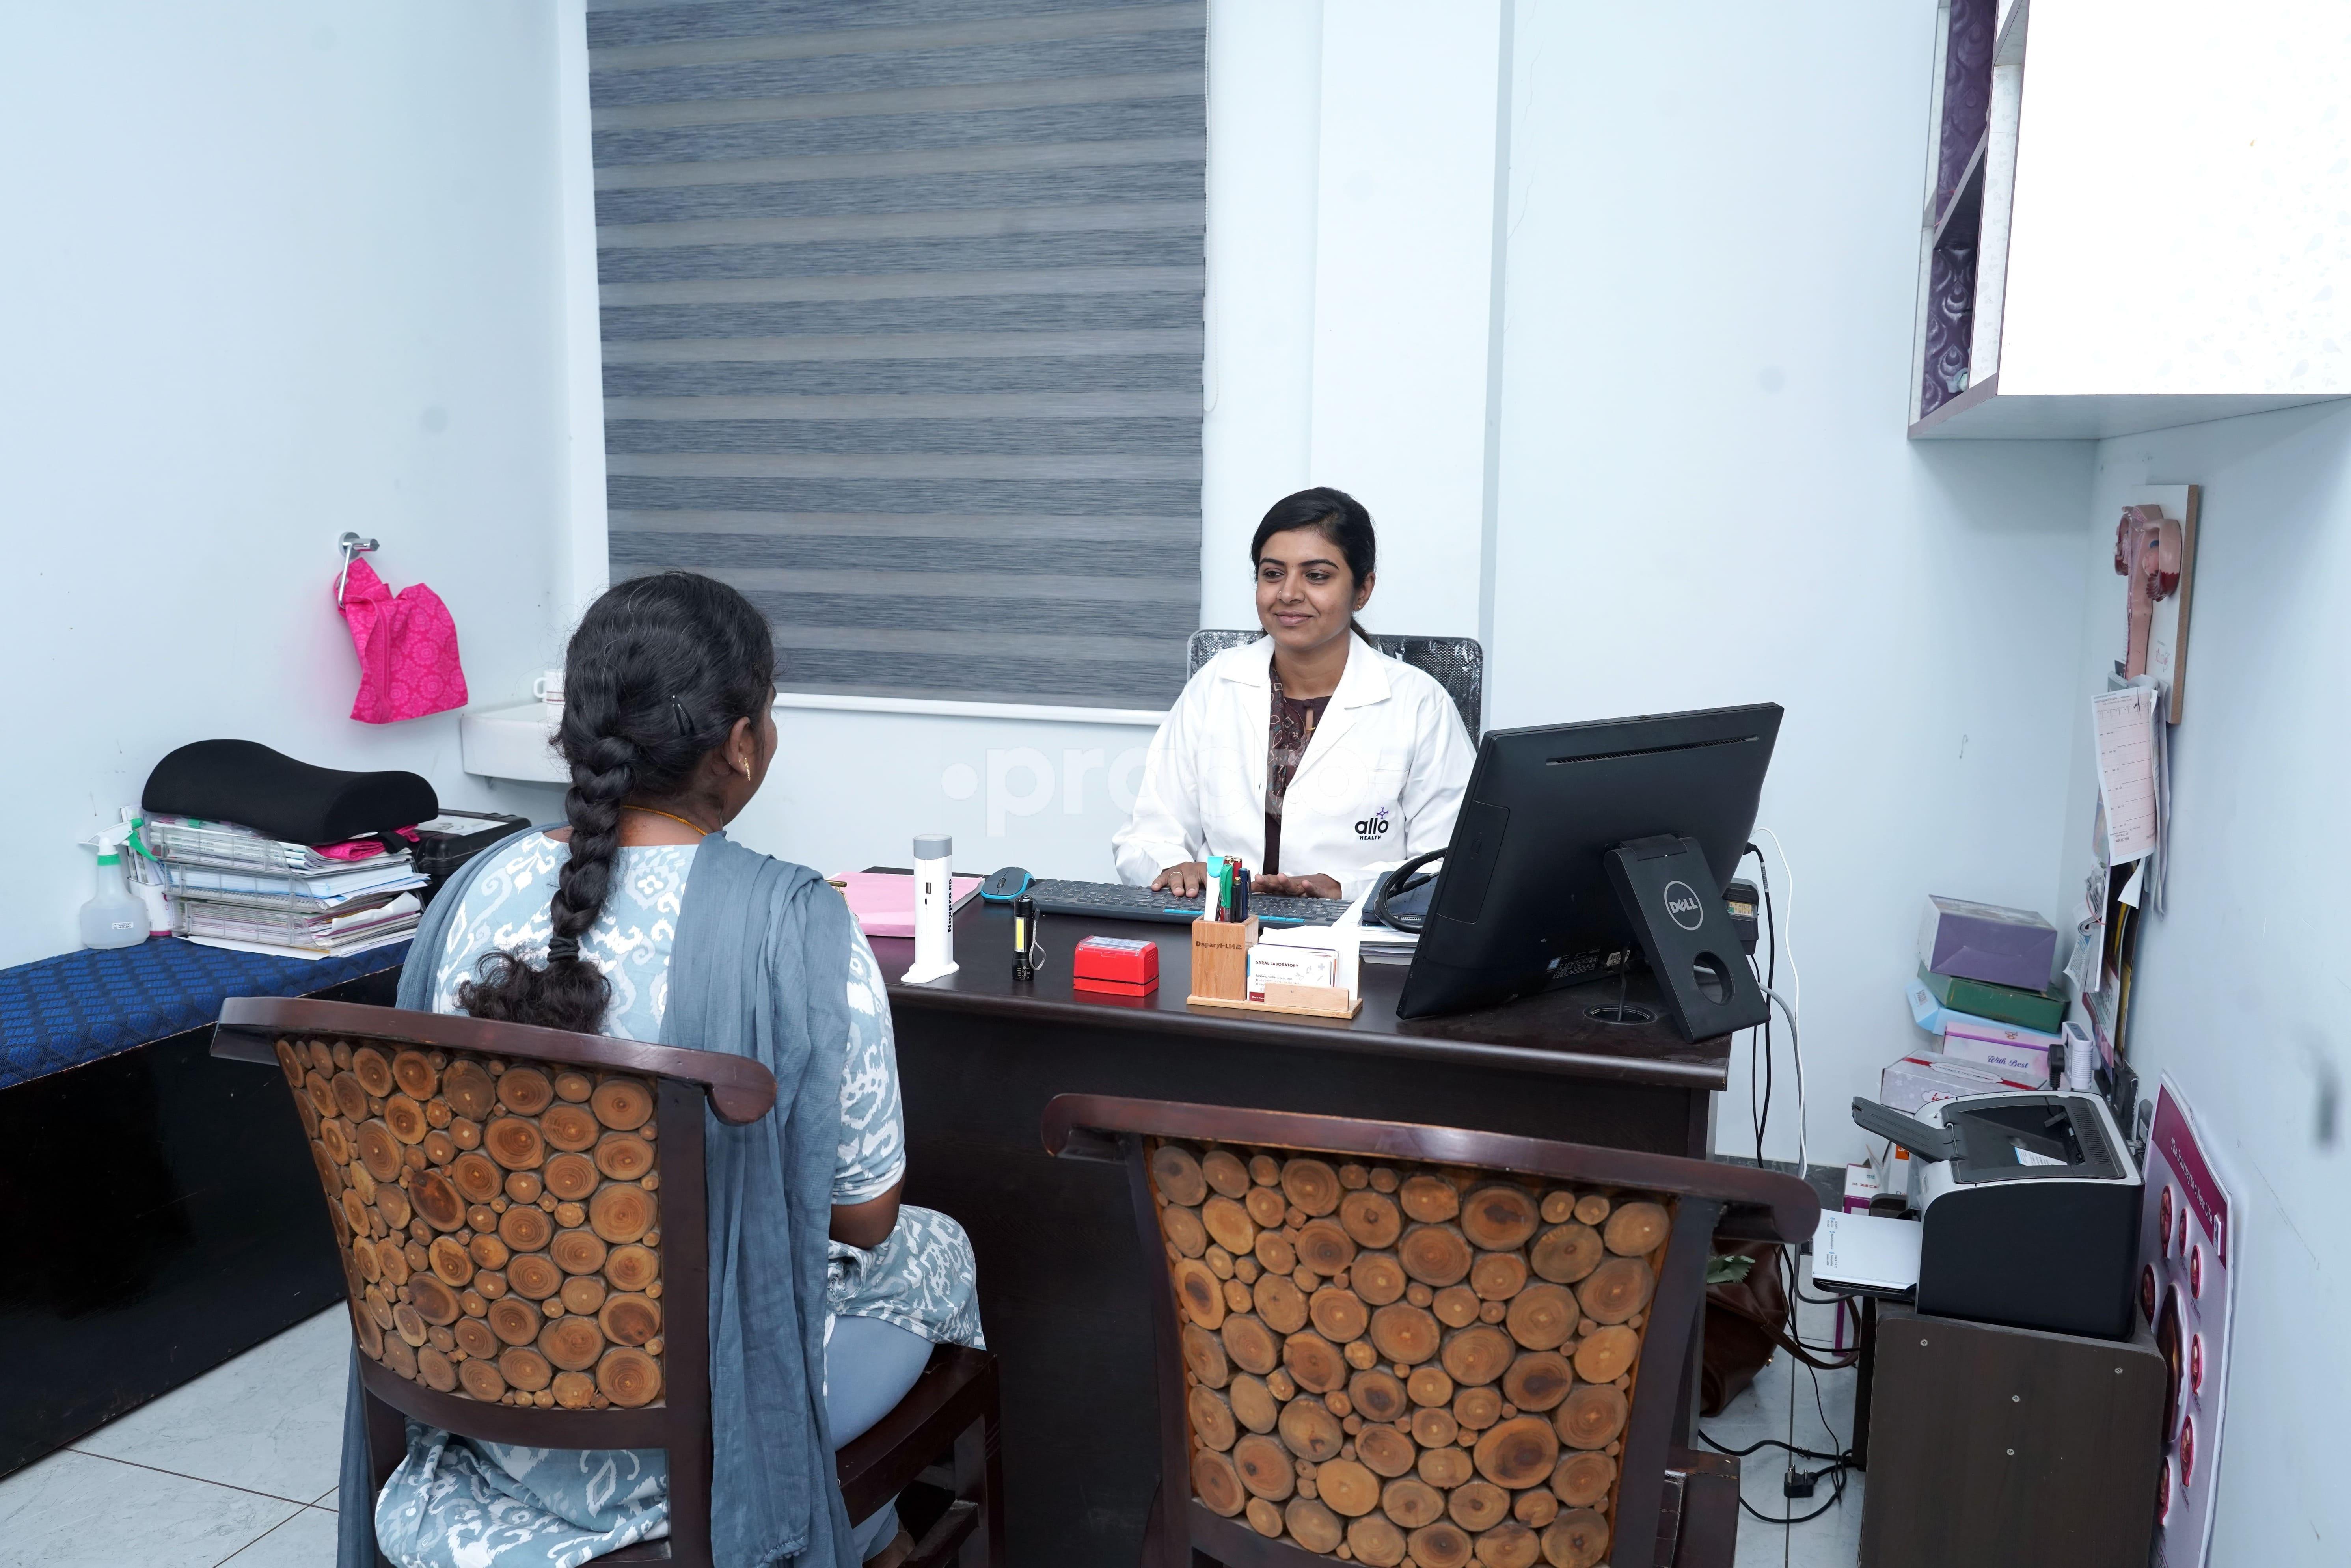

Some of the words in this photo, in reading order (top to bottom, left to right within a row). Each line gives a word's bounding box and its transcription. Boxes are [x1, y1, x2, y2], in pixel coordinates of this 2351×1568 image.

[1355, 818, 1389, 834] allo
[949, 879, 952, 890] RD
[1669, 898, 1698, 913] DELL
[1988, 1055, 2006, 1065] With
[2008, 1059, 2029, 1068] Best
[2177, 1149, 2190, 1184] Journey
[2190, 1175, 2194, 1190] to
[2194, 1186, 2197, 1196] a
